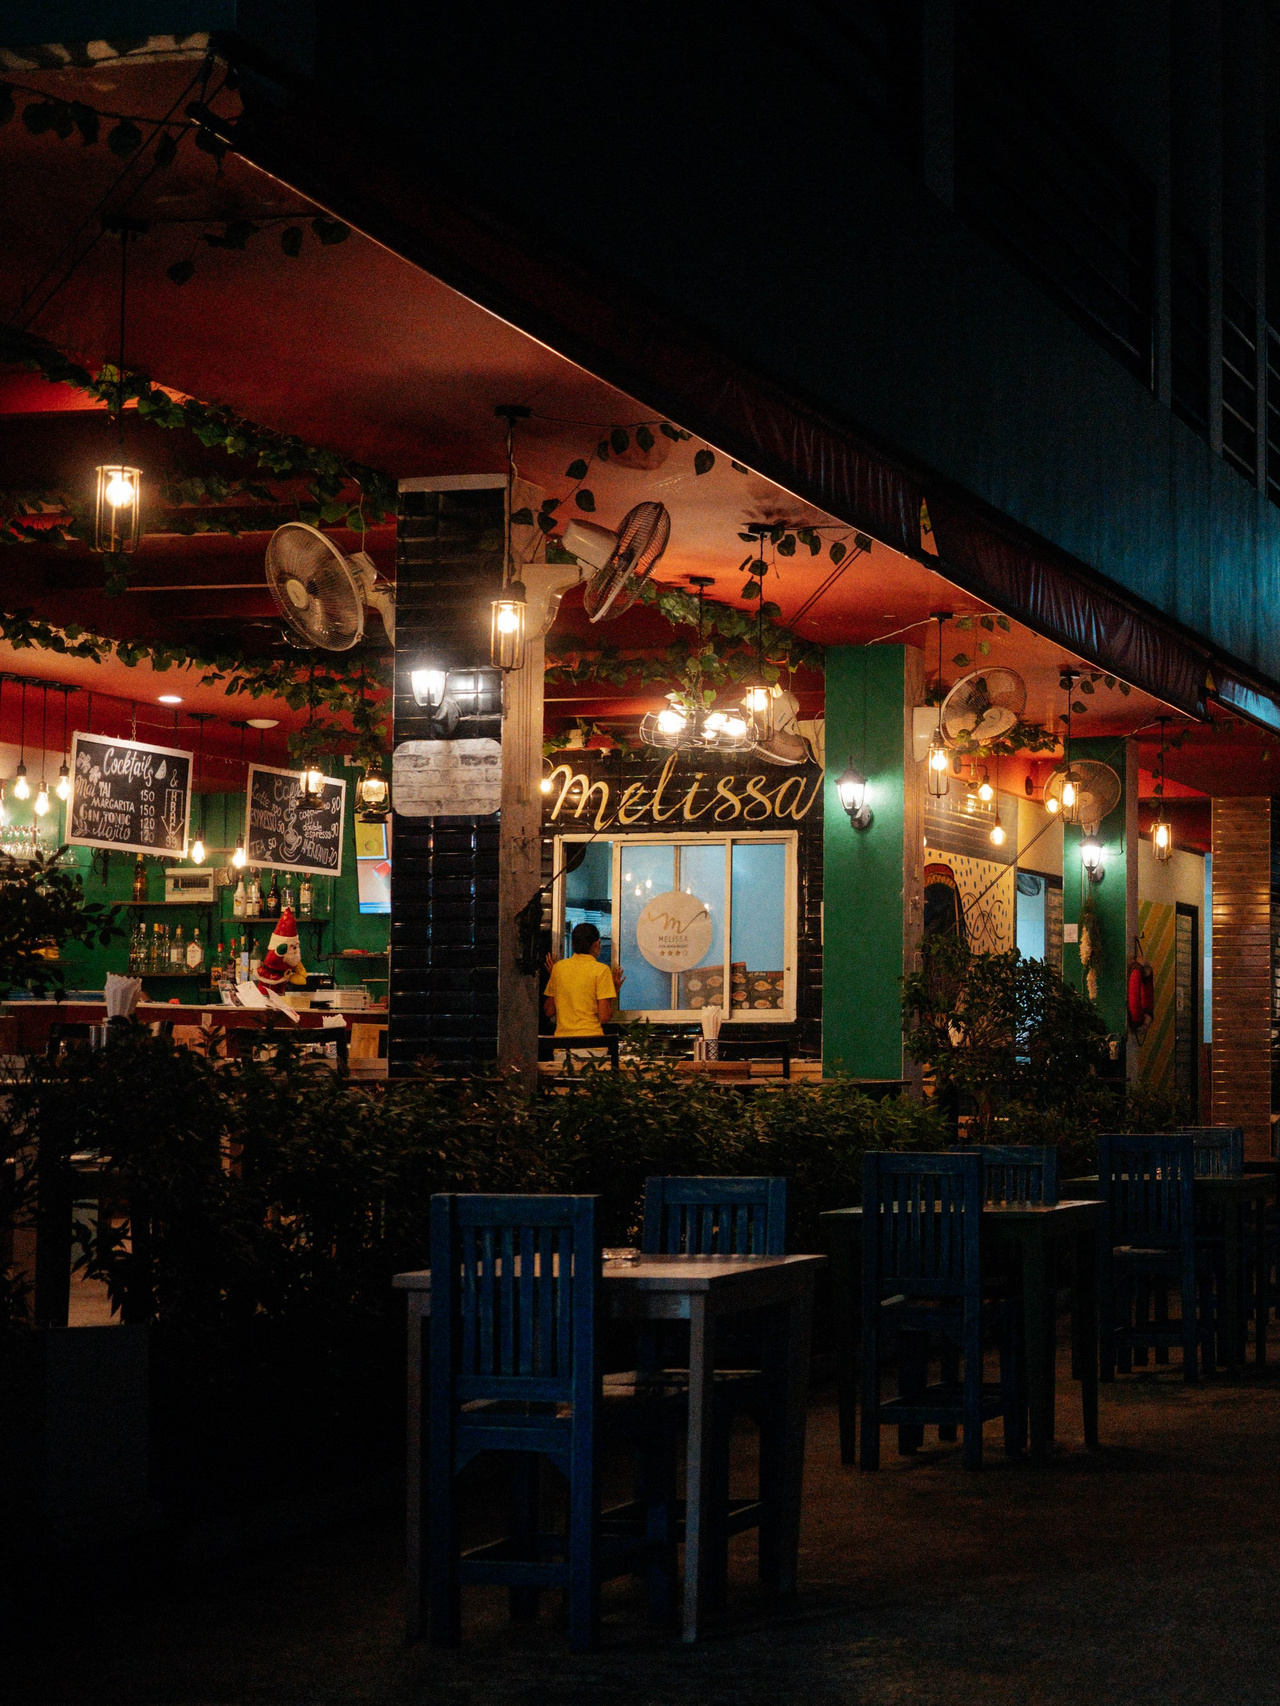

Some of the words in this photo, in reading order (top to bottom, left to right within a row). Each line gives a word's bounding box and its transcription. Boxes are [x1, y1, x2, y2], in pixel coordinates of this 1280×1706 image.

[103, 747, 153, 787] Cocktails
[99, 781, 111, 798] TAI
[140, 790, 155, 802] 150
[91, 797, 135, 813] MARGARITA
[140, 804, 155, 817] 150
[103, 811, 131, 826] TONIC
[140, 818, 155, 830] 120
